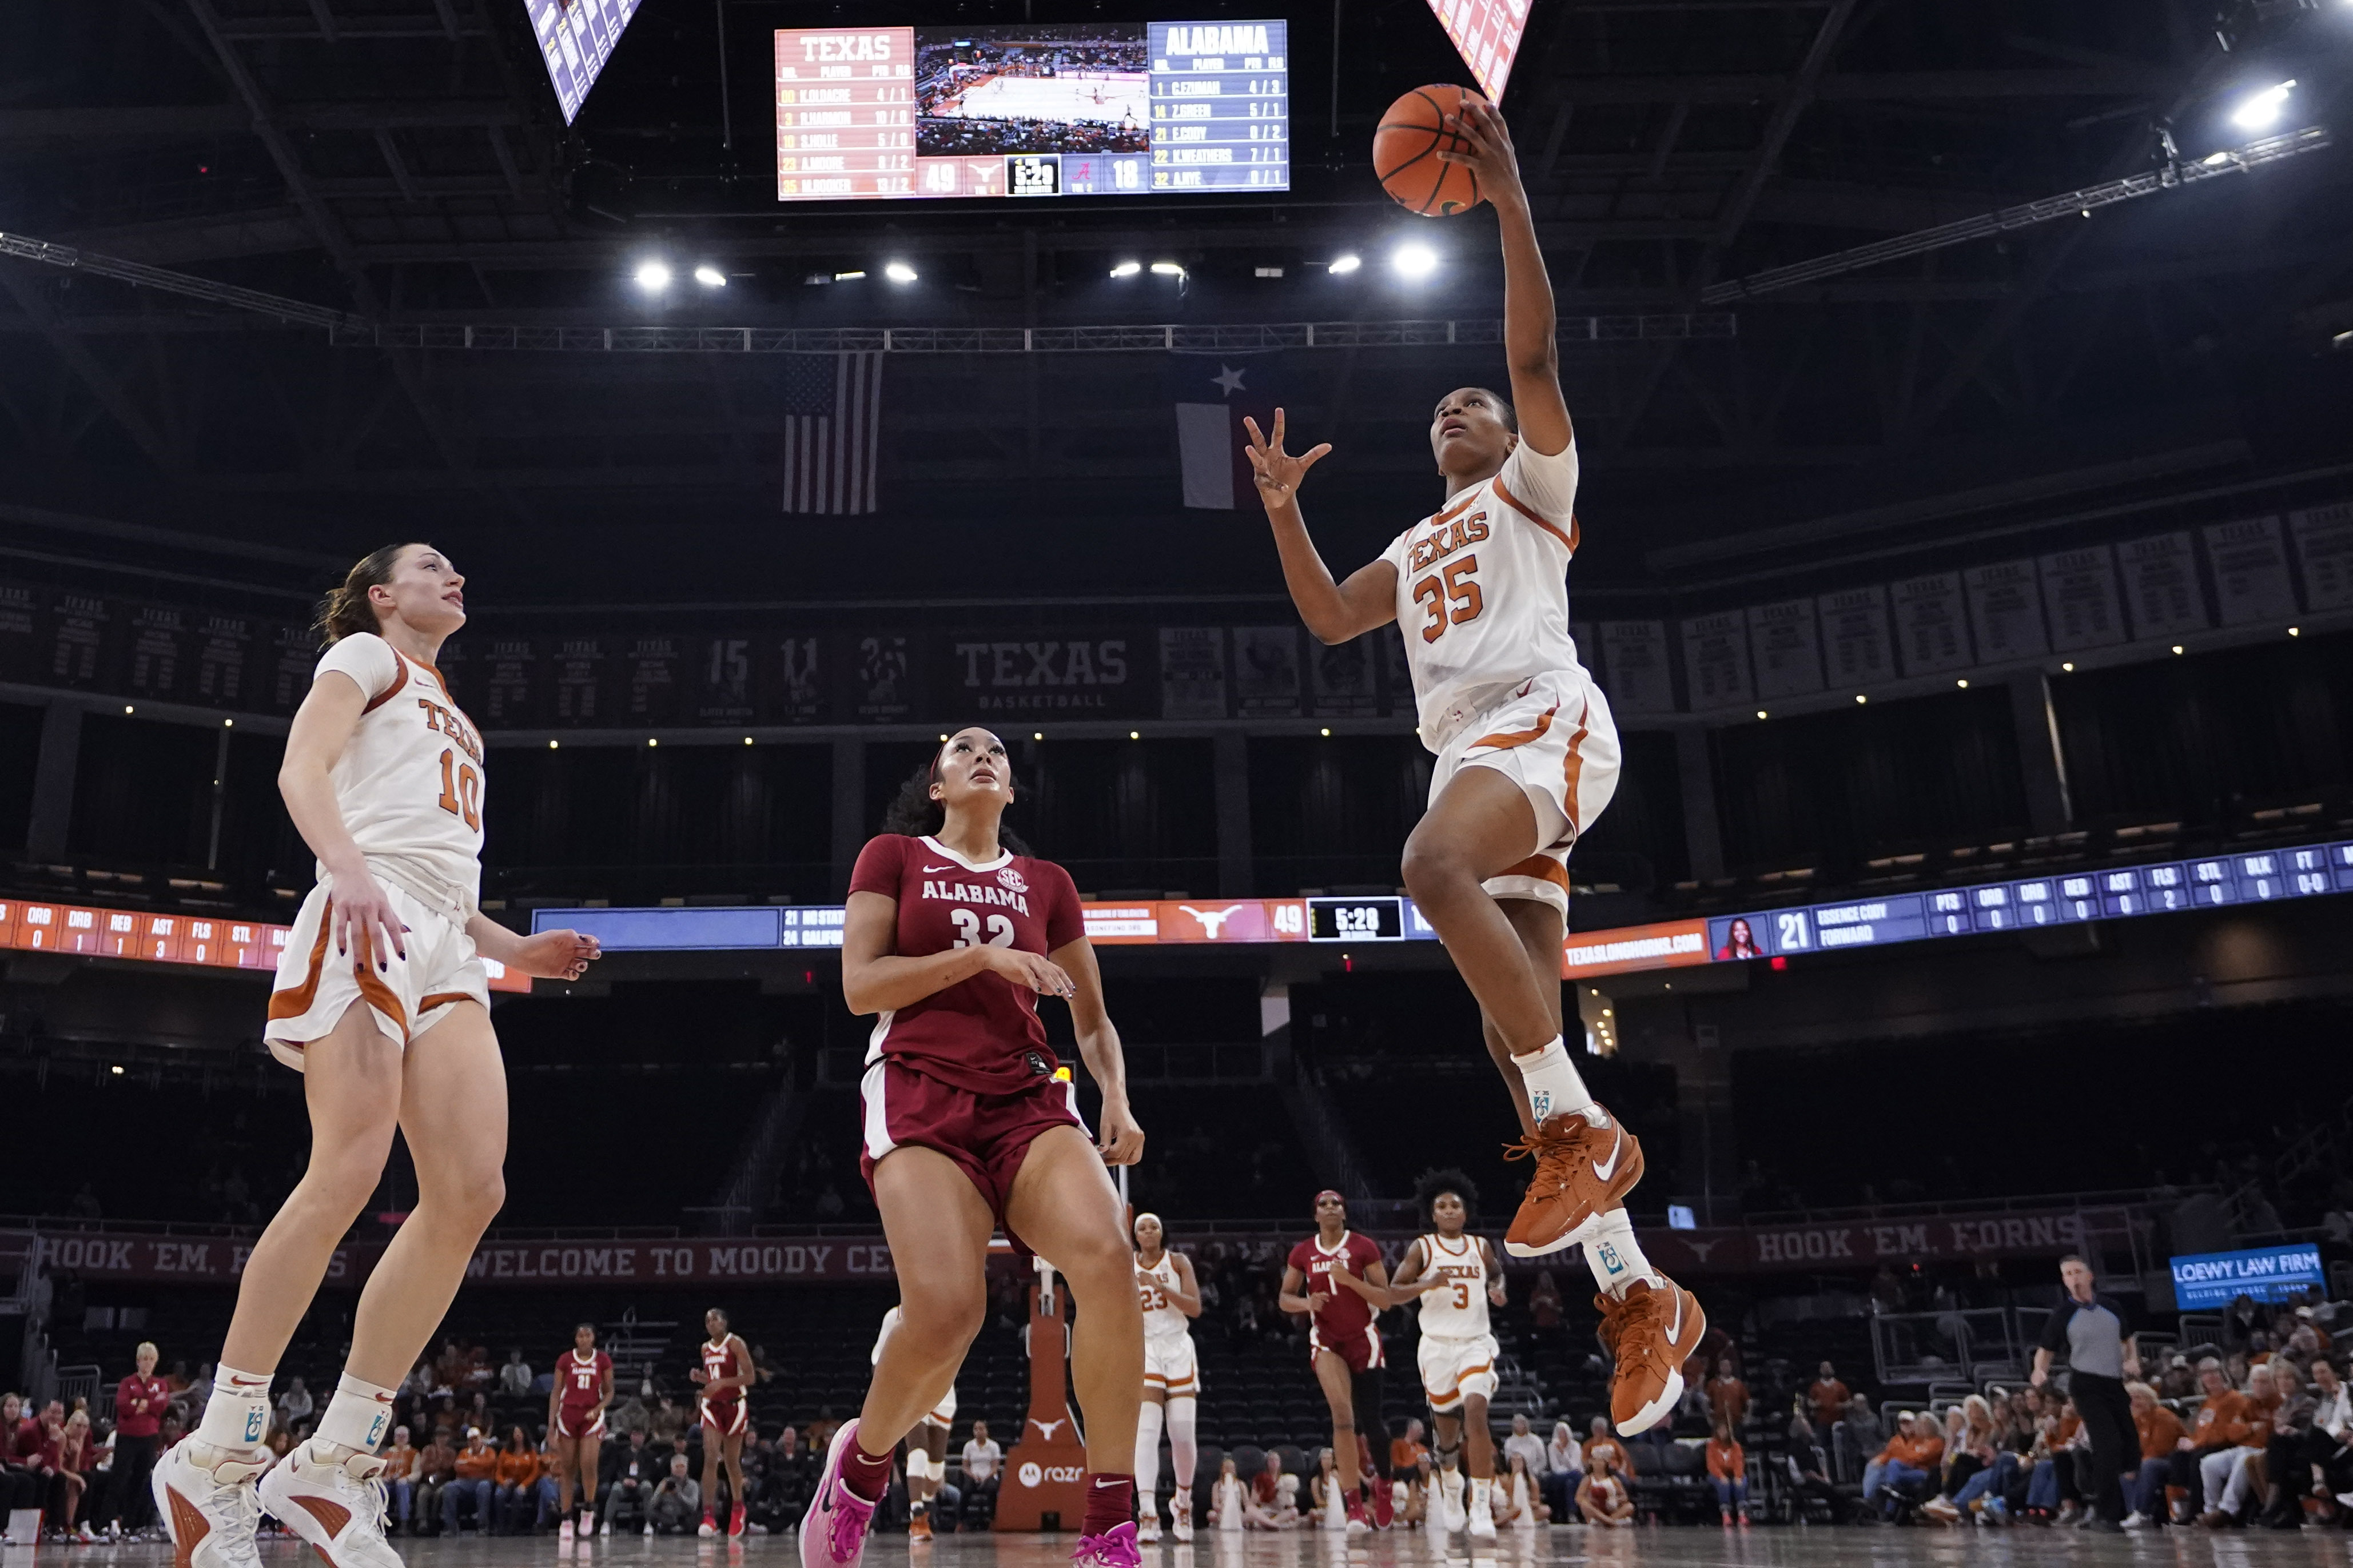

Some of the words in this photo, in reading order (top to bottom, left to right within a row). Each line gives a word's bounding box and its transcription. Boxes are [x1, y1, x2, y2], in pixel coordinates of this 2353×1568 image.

[801, 35, 891, 62] TEXAS
[1166, 26, 1269, 55] ALABAMA
[820, 66, 852, 78] PLAYER
[781, 90, 795, 103] 00
[877, 88, 885, 101] 4
[900, 87, 906, 101] 1
[1157, 82, 1163, 95] 1
[1249, 80, 1257, 94] 4
[1271, 79, 1280, 93] 3
[785, 113, 793, 126] 3
[875, 110, 887, 124] 10
[899, 110, 907, 124] 0
[1249, 103, 1257, 117] 5
[1273, 103, 1279, 116] 1
[783, 135, 795, 148] 10
[878, 133, 886, 147] 5
[900, 133, 907, 146] 0
[1155, 127, 1167, 141] 21
[1250, 125, 1257, 139] 0
[1272, 125, 1280, 139] 2
[783, 157, 797, 171] 23
[900, 155, 908, 169] 2
[1154, 150, 1169, 163] 22
[1250, 148, 1258, 162] 7
[1274, 148, 1280, 161] 1
[783, 180, 797, 193] 35
[901, 177, 909, 191] 2
[925, 164, 956, 192] 49
[1015, 165, 1053, 186] 5:29
[1113, 160, 1138, 189] 18
[1154, 172, 1169, 186] 32
[1250, 170, 1258, 184] 0
[1274, 170, 1280, 183] 1
[1413, 554, 1483, 644] 35
[711, 640, 748, 684] 15
[956, 640, 1127, 687] TEXAS
[978, 694, 1106, 709] BASKETBALL
[439, 748, 480, 833] 10
[1001, 869, 1022, 887] SEC
[1936, 893, 1961, 912] PTS
[2064, 878, 2089, 897] REB
[2108, 872, 2133, 892] AST
[2152, 867, 2177, 887] FLS
[2197, 862, 2223, 881] STL
[2244, 856, 2274, 876] BLK
[2295, 851, 2314, 871] FT
[922, 881, 1029, 917] ALABAMA
[1947, 915, 1958, 933] 0
[1990, 910, 2002, 929] 0
[2033, 905, 2045, 924] 0
[2076, 900, 2088, 919] 0
[2119, 895, 2132, 915] 0
[2164, 889, 2176, 909] 2
[2210, 884, 2223, 904] 0
[2257, 879, 2271, 900] 0
[27, 907, 53, 925] ORB
[69, 911, 93, 928] DRB
[110, 915, 132, 932] REB
[152, 918, 174, 936] AST
[192, 922, 212, 939] FLS
[232, 925, 251, 943] STL
[785, 910, 798, 925] 21
[818, 910, 846, 925] STAT
[1273, 905, 1303, 933] 49
[1335, 907, 1379, 931] 5:28
[1817, 907, 1860, 926] ESSENCE
[1860, 903, 1886, 921] CODY
[783, 930, 798, 946] 24
[950, 908, 1015, 949] 32
[1779, 912, 1808, 950] 21
[1820, 924, 1873, 947] FORWARD
[33, 929, 42, 948] 0
[77, 934, 83, 951] 1
[117, 937, 123, 955] 1
[156, 940, 165, 958] 3
[196, 944, 206, 962] 0
[238, 948, 245, 965] 1
[1566, 933, 1703, 967] TEXASLONGHORNS.COM
[39, 1237, 134, 1270] HOOK
[1758, 1228, 1852, 1263] HOOK
[466, 1248, 636, 1278] WELCOME
[650, 1248, 694, 1276] TO
[708, 1246, 832, 1275] MOODY
[2173, 1260, 2233, 1283] LOEWY
[2236, 1256, 2277, 1276] LAW
[2279, 1252, 2320, 1273] FIRM
[1140, 1290, 1168, 1312] 23
[1453, 1283, 1469, 1310] 3
[1044, 1466, 1085, 1482] razr
